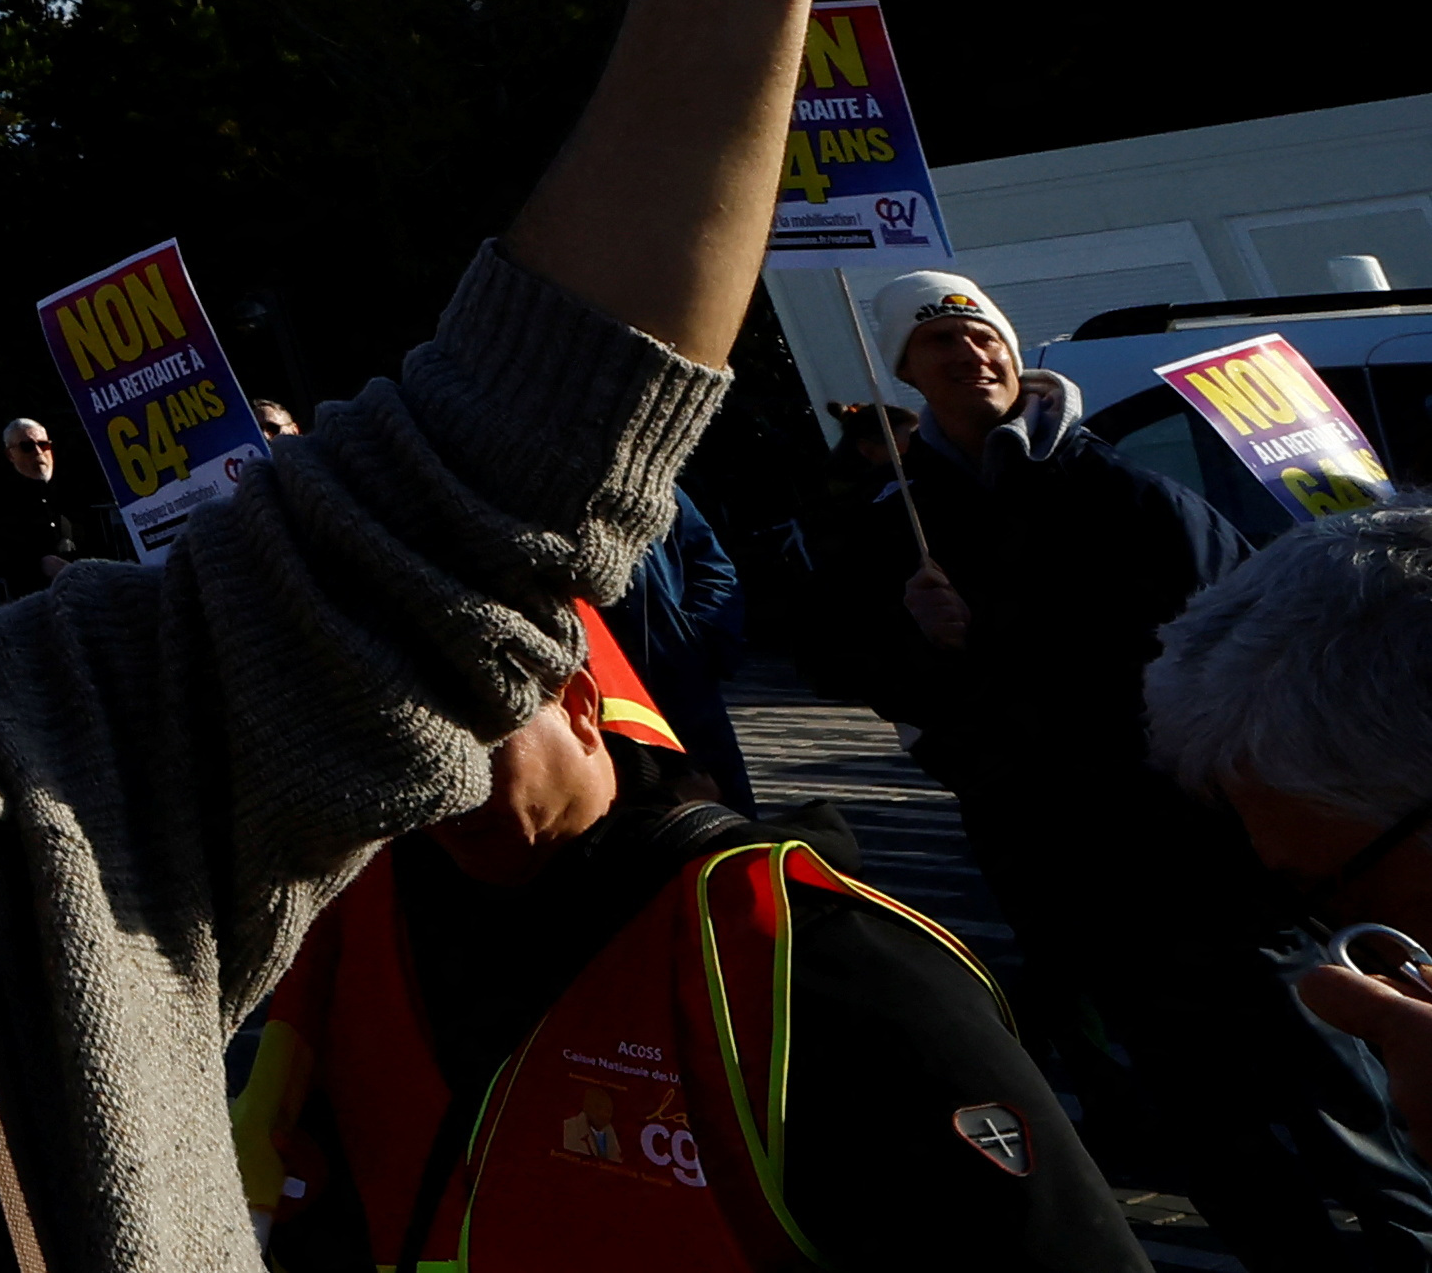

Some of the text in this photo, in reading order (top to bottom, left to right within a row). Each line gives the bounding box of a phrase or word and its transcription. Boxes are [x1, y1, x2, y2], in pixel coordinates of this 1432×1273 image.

[866, 93, 883, 118] À
[781, 127, 895, 204] 4 ANS
[56, 263, 186, 381] NON
[90, 344, 205, 413] À LA RETRAITE À
[1184, 350, 1331, 436] NON
[107, 380, 225, 497] 64 ANS
[1267, 437, 1293, 462] LA
[618, 1041, 662, 1061] ACOSS
[640, 1123, 707, 1187] cg
